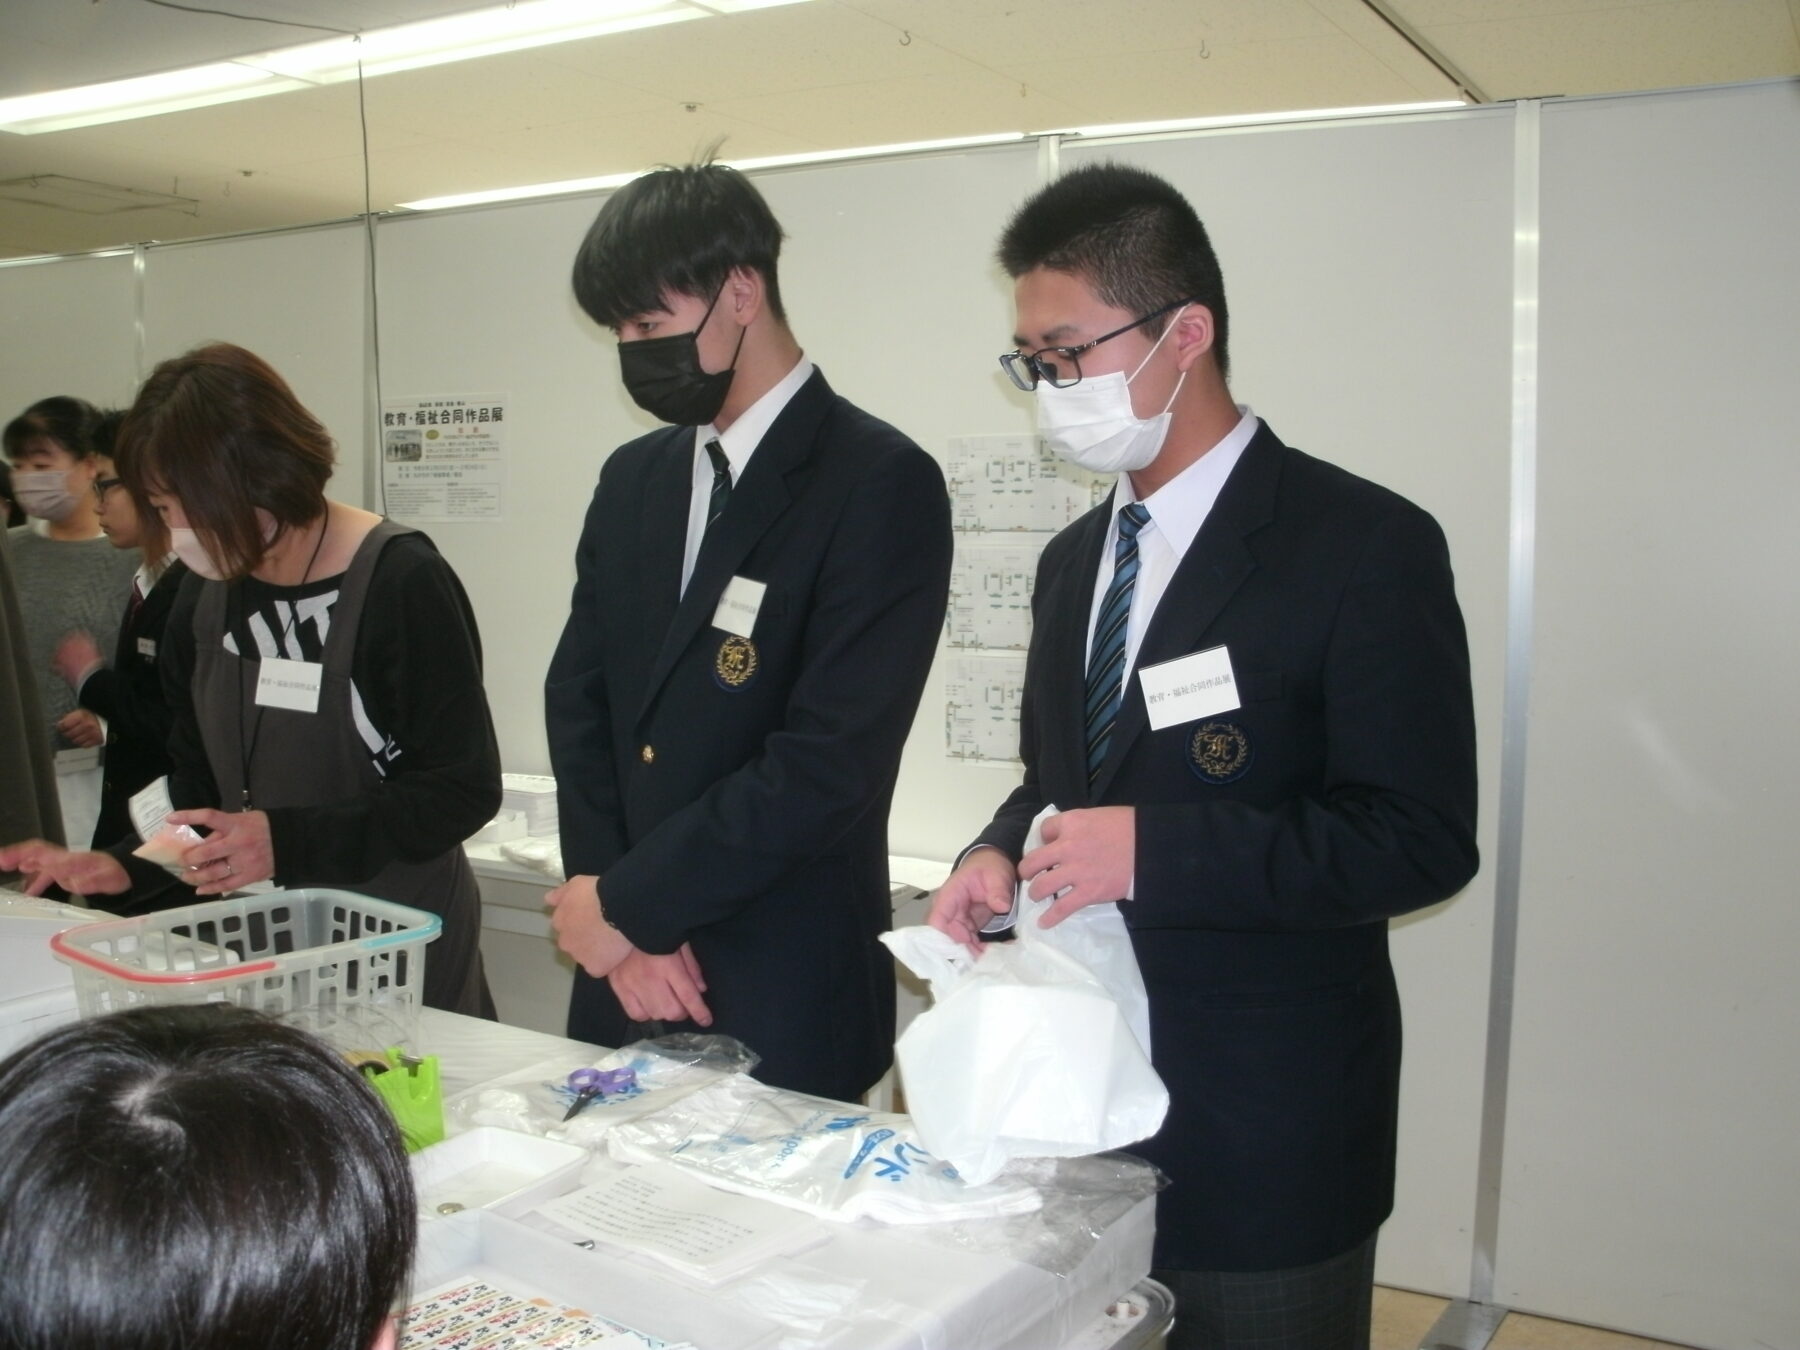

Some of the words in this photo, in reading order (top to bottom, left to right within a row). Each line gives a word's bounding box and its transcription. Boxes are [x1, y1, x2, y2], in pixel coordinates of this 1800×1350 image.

[384, 407, 504, 427] 教育・福祉合同作品展
[1149, 674, 1232, 704] 教育・福祉合同作品展
